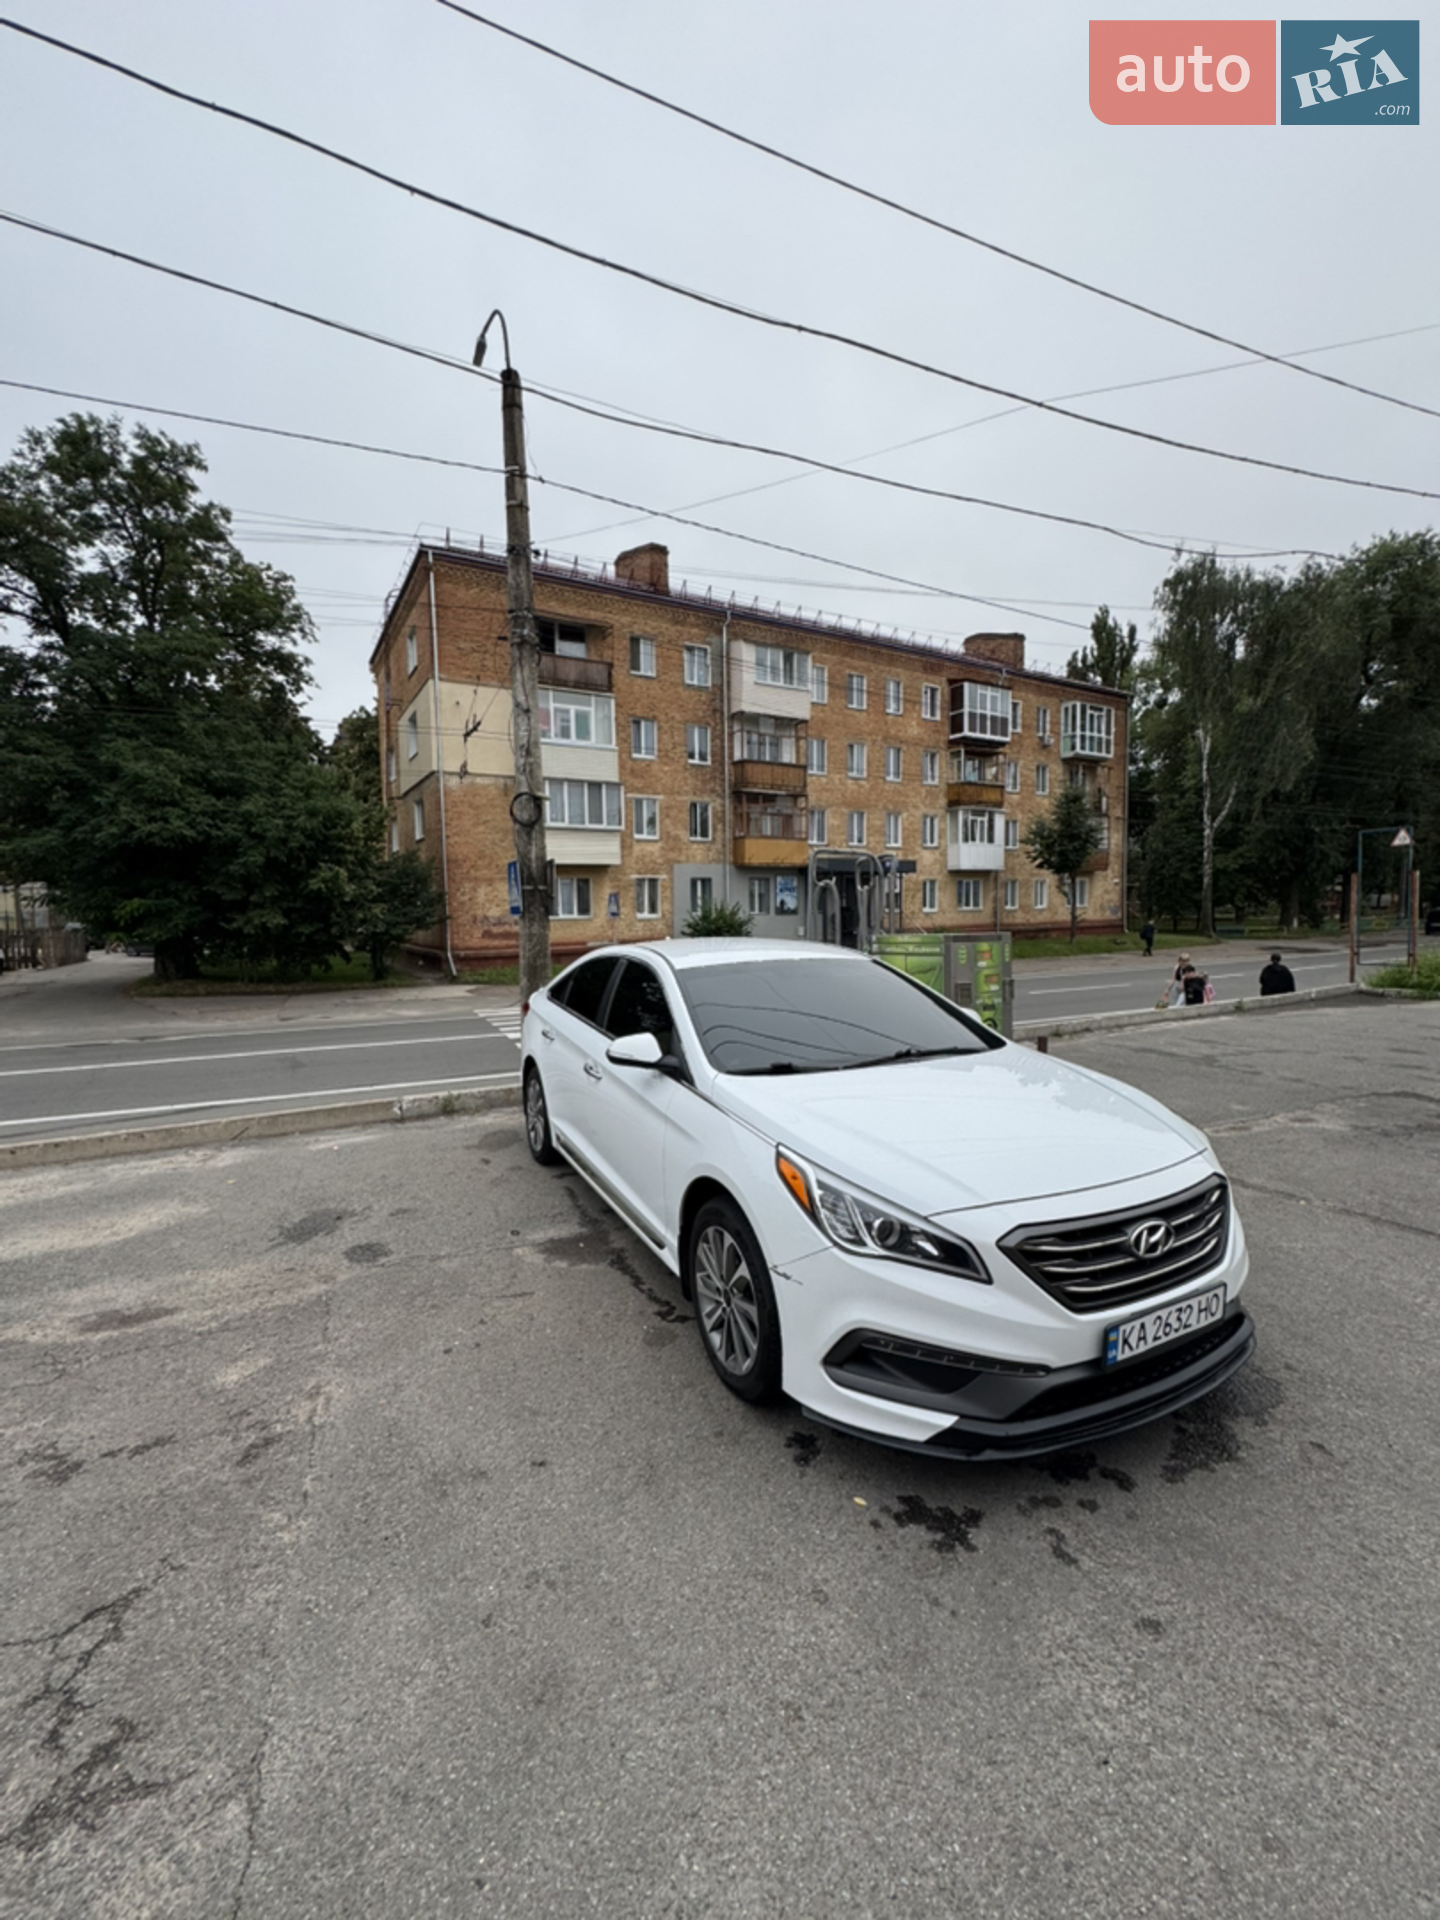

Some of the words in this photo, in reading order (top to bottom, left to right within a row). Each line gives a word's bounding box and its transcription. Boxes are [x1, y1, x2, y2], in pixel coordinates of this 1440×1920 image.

[1121, 1322, 1148, 1355] KA
[1152, 1304, 1194, 1343] 2632
[1196, 1293, 1220, 1325] HO
